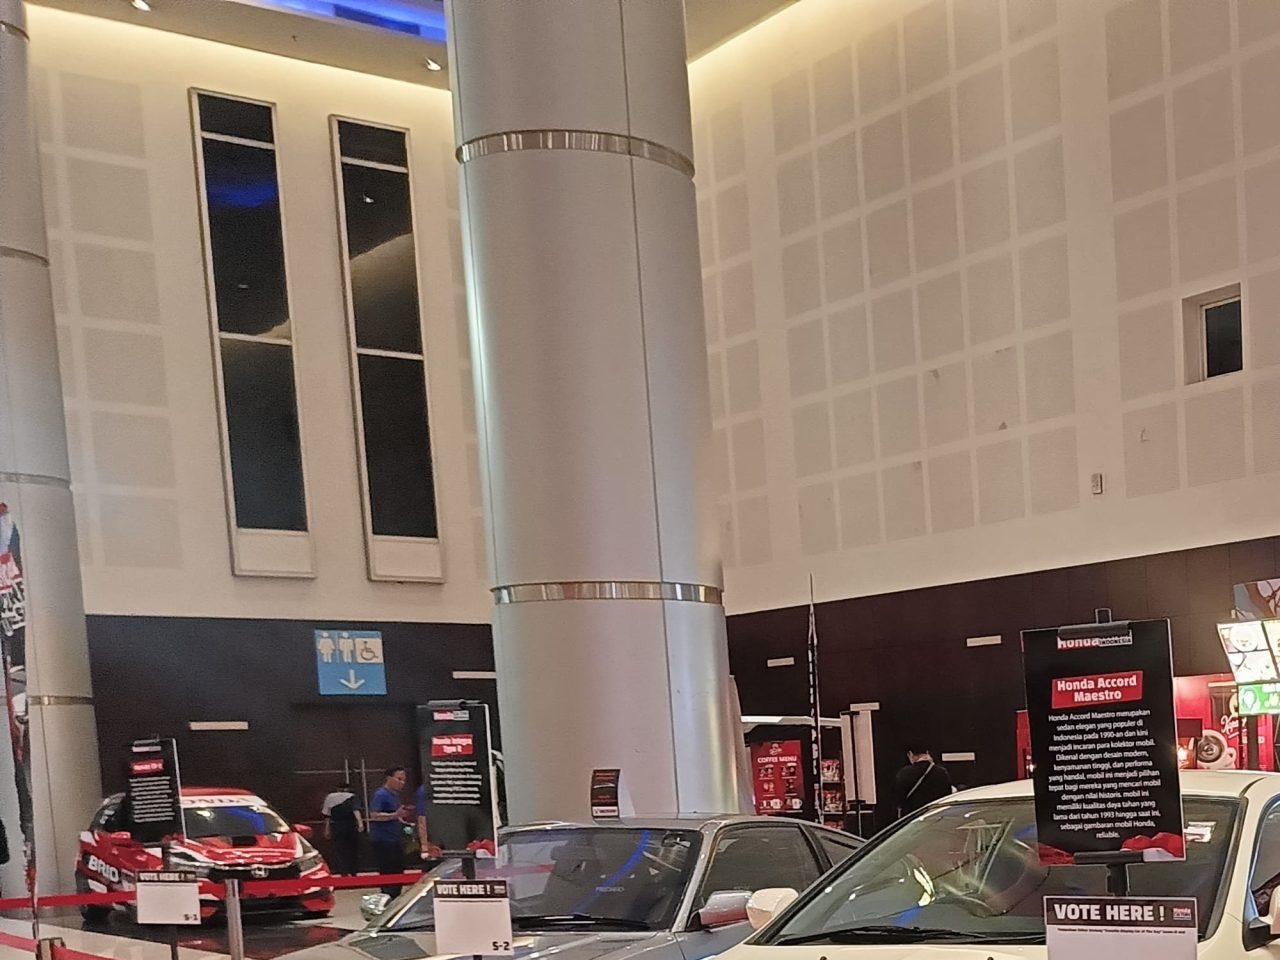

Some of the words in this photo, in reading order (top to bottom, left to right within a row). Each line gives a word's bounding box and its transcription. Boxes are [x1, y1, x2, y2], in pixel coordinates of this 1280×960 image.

[1057, 679, 1095, 691] Honda
[1097, 675, 1137, 688] Accord
[1073, 690, 1122, 702] Maestro
[88, 855, 119, 882] BRIO
[436, 884, 458, 895] VOTE
[460, 884, 485, 895] HERE
[1054, 903, 1100, 920] VOTE
[1106, 905, 1154, 921] HERE
[492, 941, 510, 951] S-2
